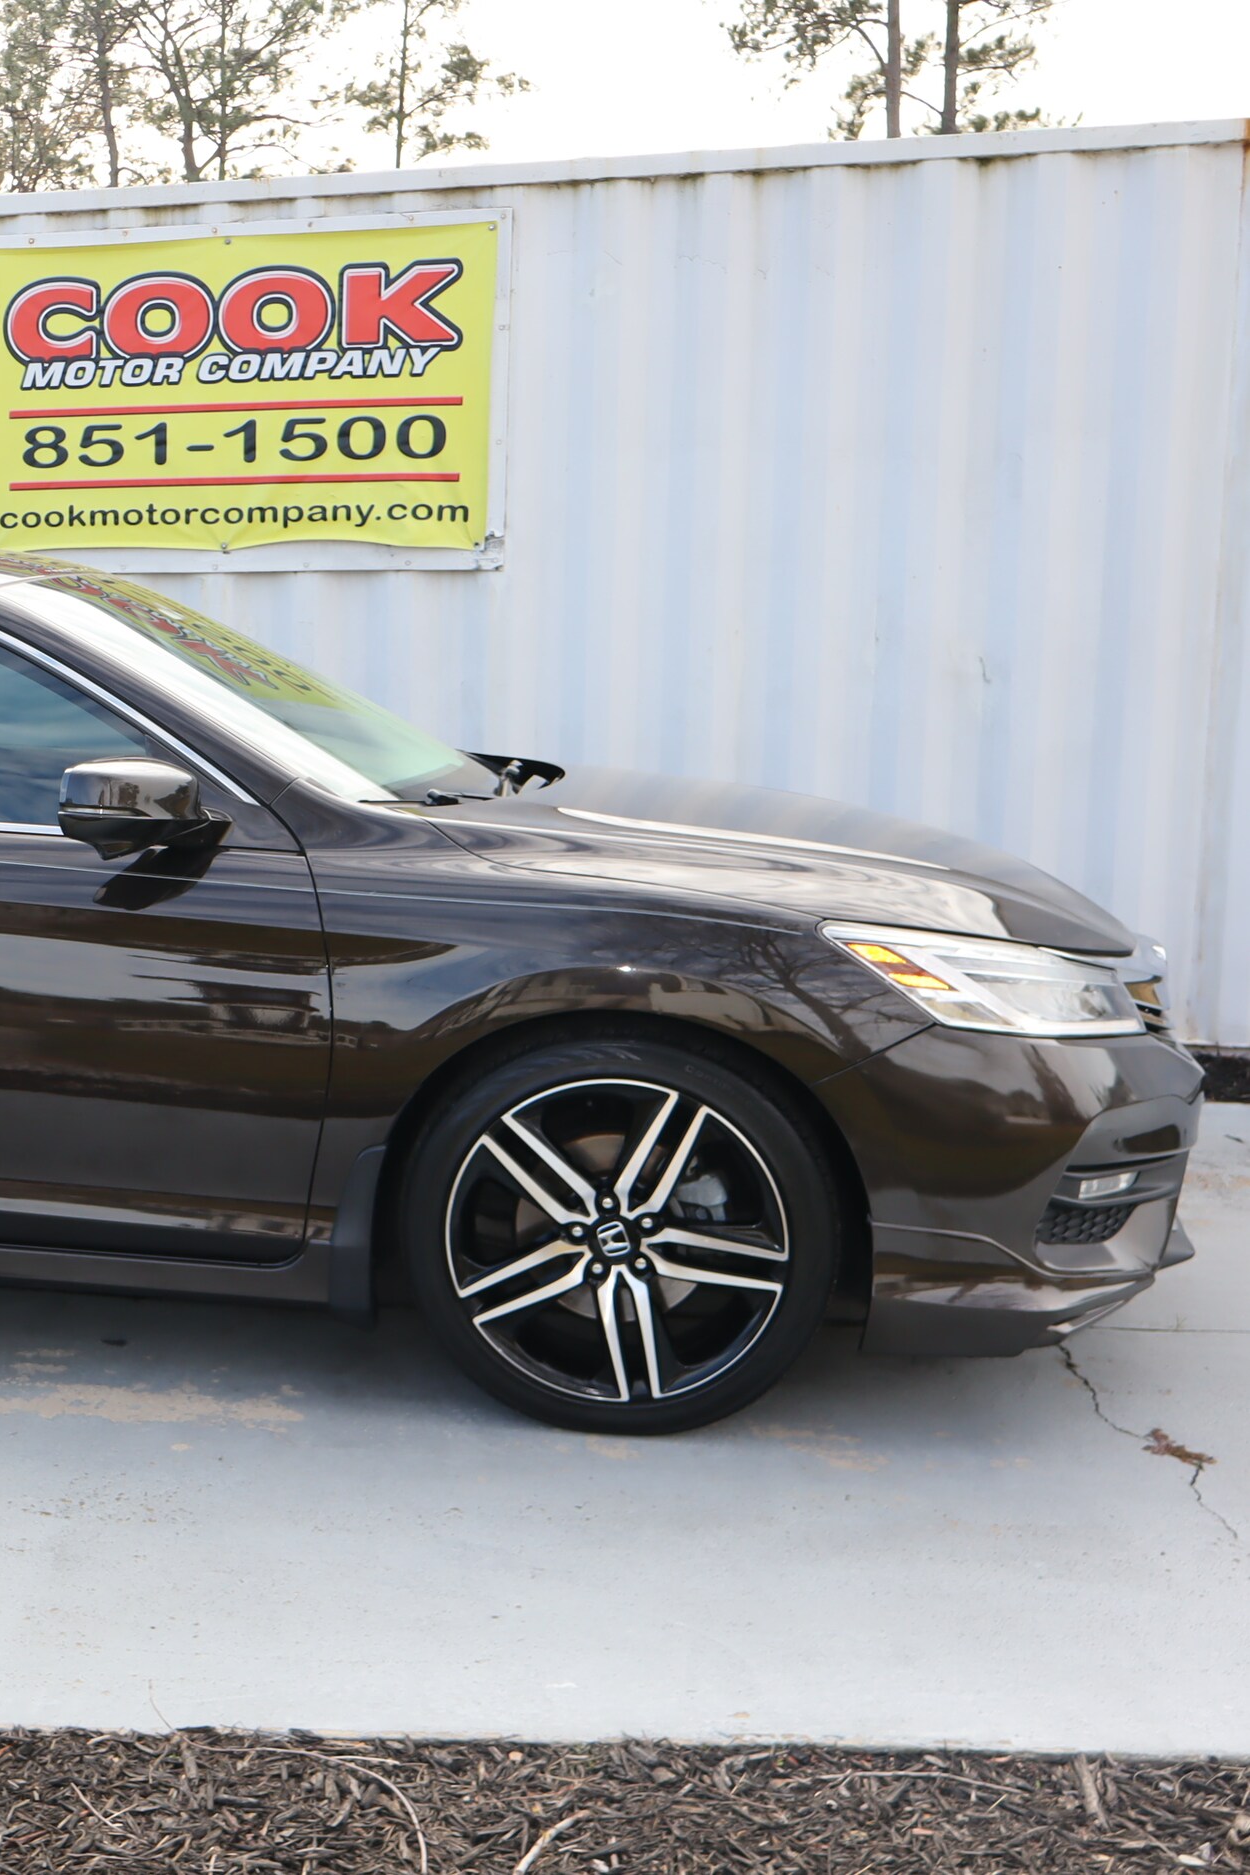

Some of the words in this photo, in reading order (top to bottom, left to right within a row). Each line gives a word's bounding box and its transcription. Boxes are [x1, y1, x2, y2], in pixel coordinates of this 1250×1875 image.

[3, 258, 463, 362] COOK
[21, 355, 185, 390] MOTOR
[195, 346, 442, 384] COMPANY
[21, 414, 447, 468] 851-1500
[0, 502, 469, 530] cookmotorcompany.com
